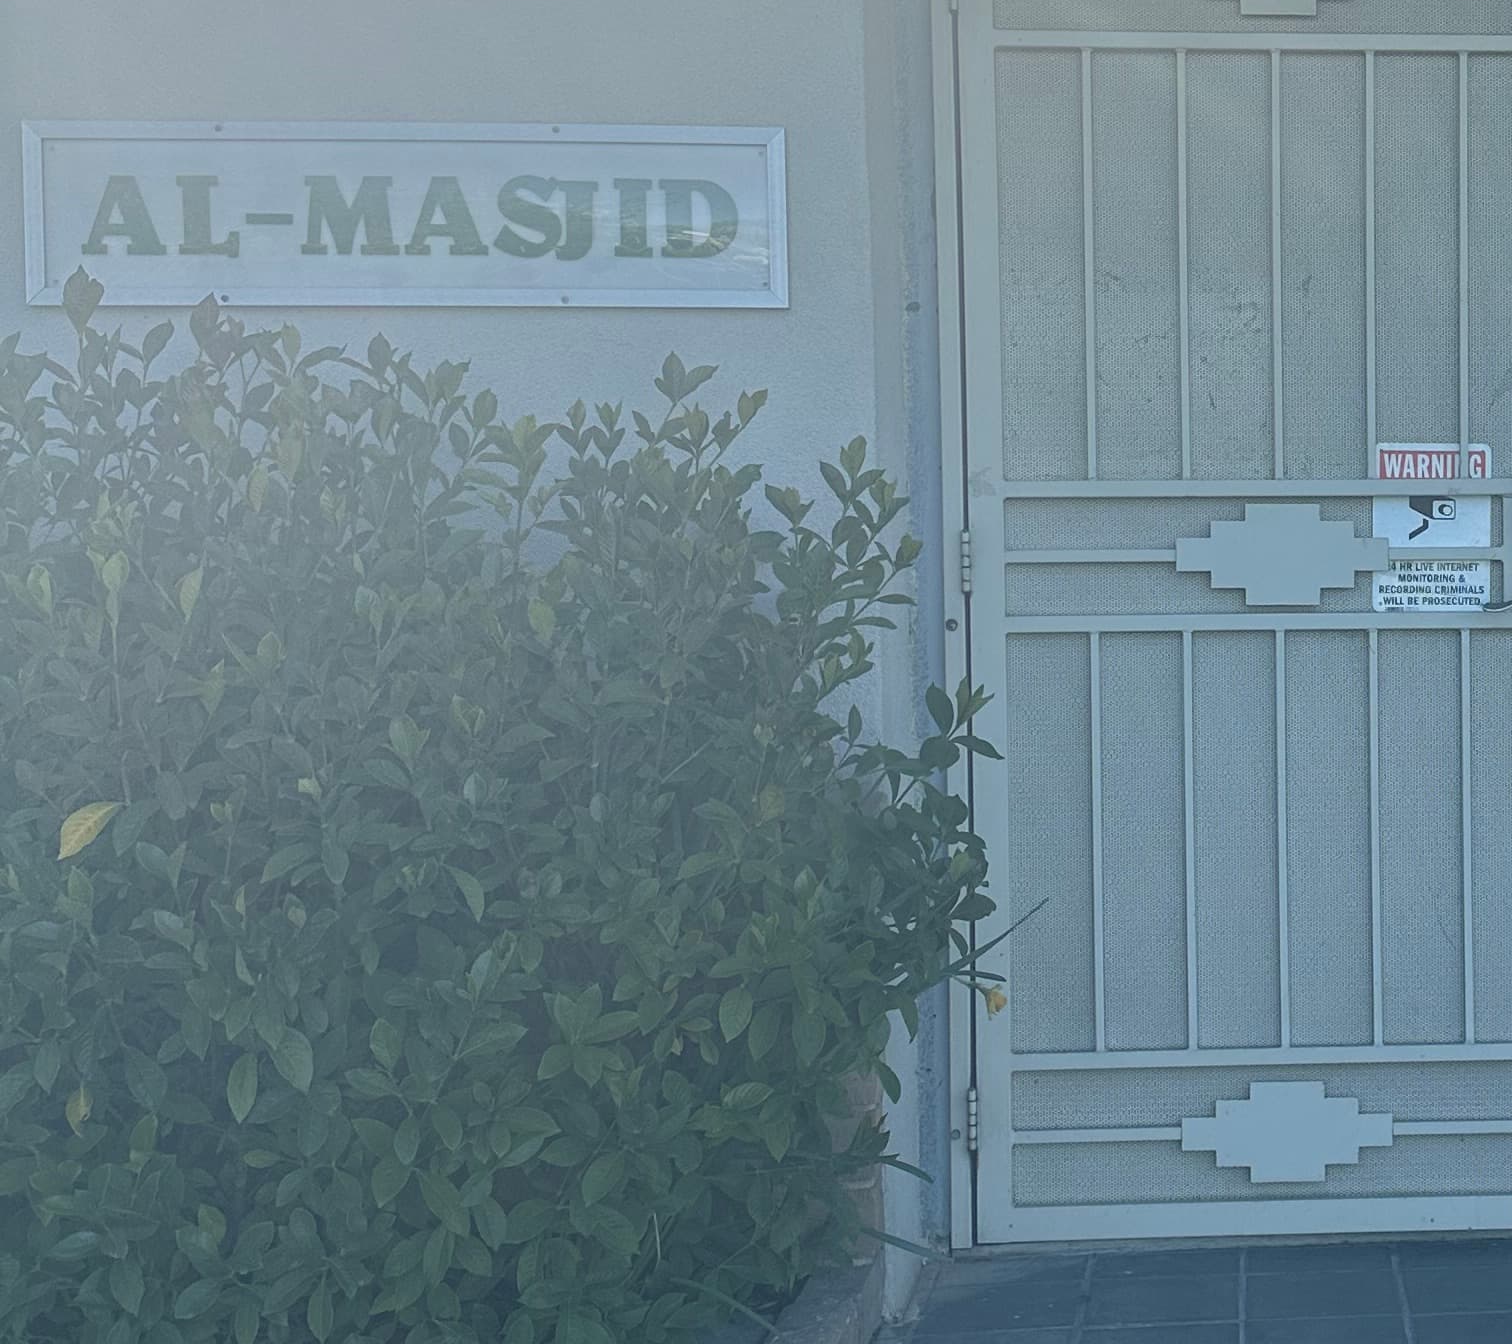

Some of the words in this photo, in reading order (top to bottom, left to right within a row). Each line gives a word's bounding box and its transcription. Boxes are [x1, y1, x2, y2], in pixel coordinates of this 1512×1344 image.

[81, 173, 739, 261] AL-MASJID
[1399, 562, 1412, 571] HR
[1415, 562, 1435, 571] LIVE
[1437, 562, 1480, 572] INTERNET
[1398, 574, 1455, 583] MONITORING
[1458, 574, 1466, 582] &
[1378, 585, 1432, 594] RECORDING
[1434, 586, 1485, 594] CRIMINALS
[1383, 596, 1404, 606] WILL
[1407, 596, 1419, 606] BE
[1422, 596, 1481, 606] PROSECUTED
